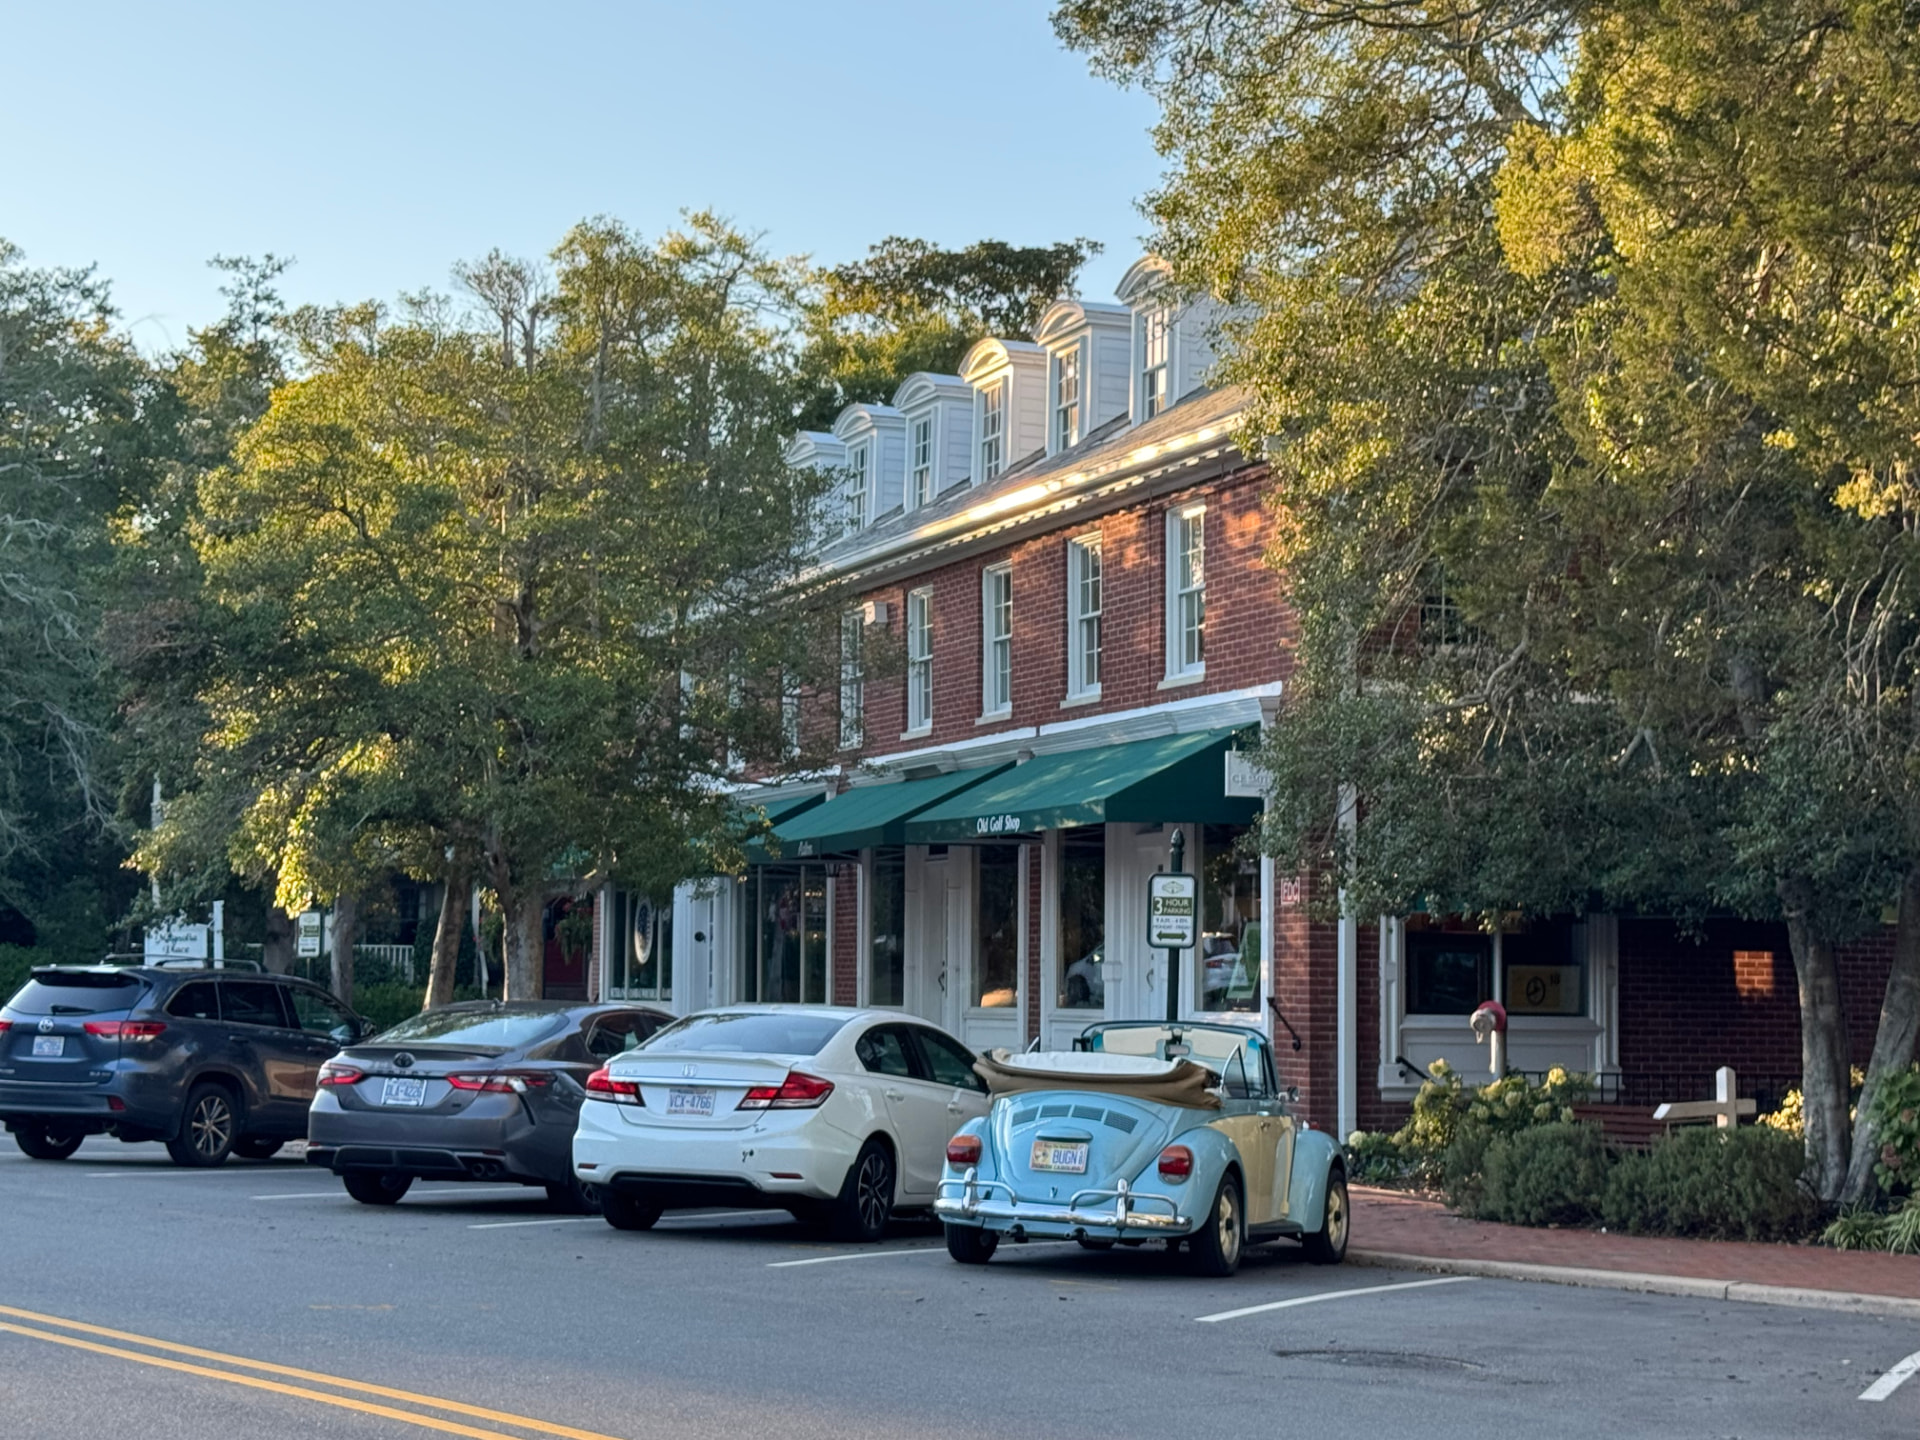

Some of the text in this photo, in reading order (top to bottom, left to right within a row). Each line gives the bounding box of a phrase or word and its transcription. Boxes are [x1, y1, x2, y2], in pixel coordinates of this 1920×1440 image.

[976, 815, 1020, 833] Old Golf Shop
[1154, 897, 1163, 915] 3
[1165, 898, 1189, 907] HOUR
[1163, 907, 1191, 915] PARKING
[163, 943, 190, 954] Place
[669, 1093, 712, 1109] VCX-4766
[1052, 1149, 1078, 1165] BUGN
